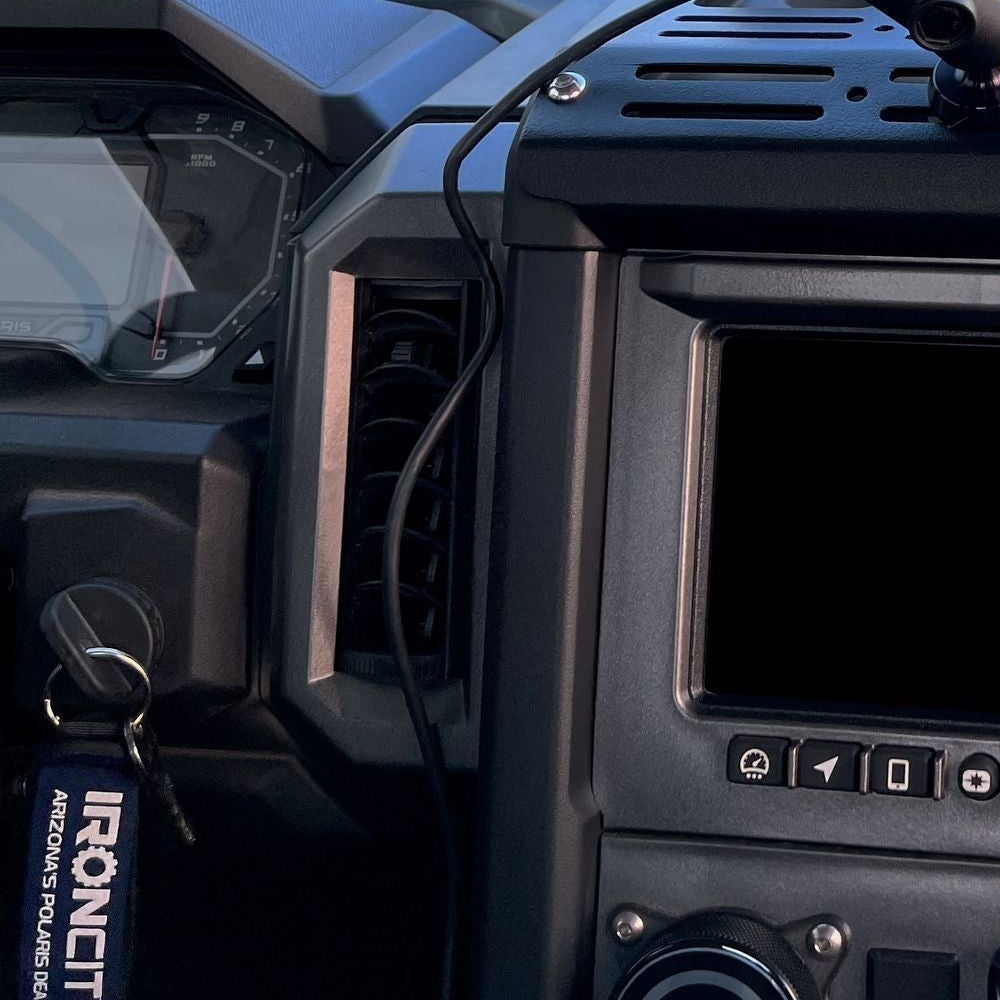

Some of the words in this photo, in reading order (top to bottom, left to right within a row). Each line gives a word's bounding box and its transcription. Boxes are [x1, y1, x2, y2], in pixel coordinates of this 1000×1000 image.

[195, 112, 210, 125] 9
[231, 120, 246, 132] 8
[265, 139, 275, 151] 7
[42, 788, 68, 889] ARIZONA'S
[64, 791, 124, 1000] IRONCIT
[34, 892, 56, 967] POLARIS
